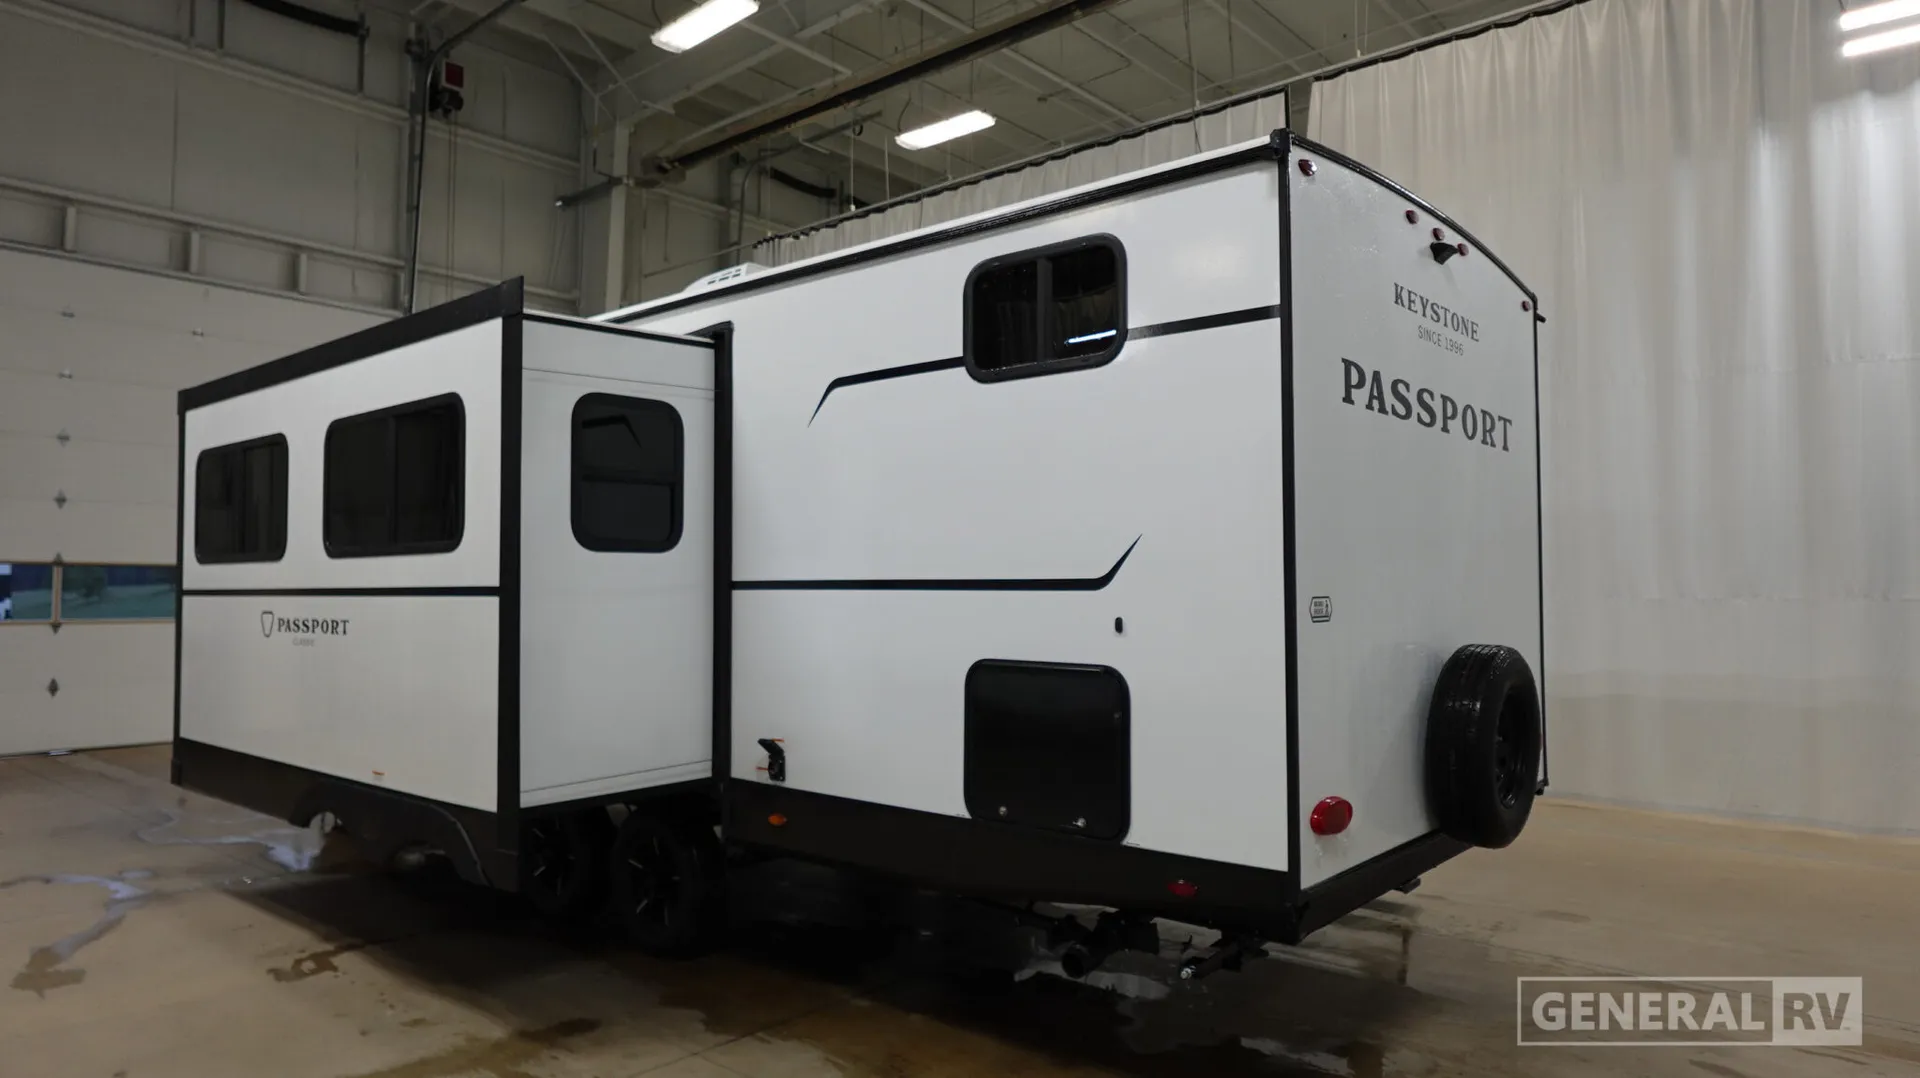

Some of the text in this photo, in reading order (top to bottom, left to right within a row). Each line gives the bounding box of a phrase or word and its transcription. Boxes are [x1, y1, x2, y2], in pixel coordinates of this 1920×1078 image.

[1393, 282, 1480, 342] KEYSTONE
[1417, 325, 1464, 356] SINCE 1996
[1341, 357, 1513, 452] PASSPORT
[277, 617, 350, 636] PASSPORT
